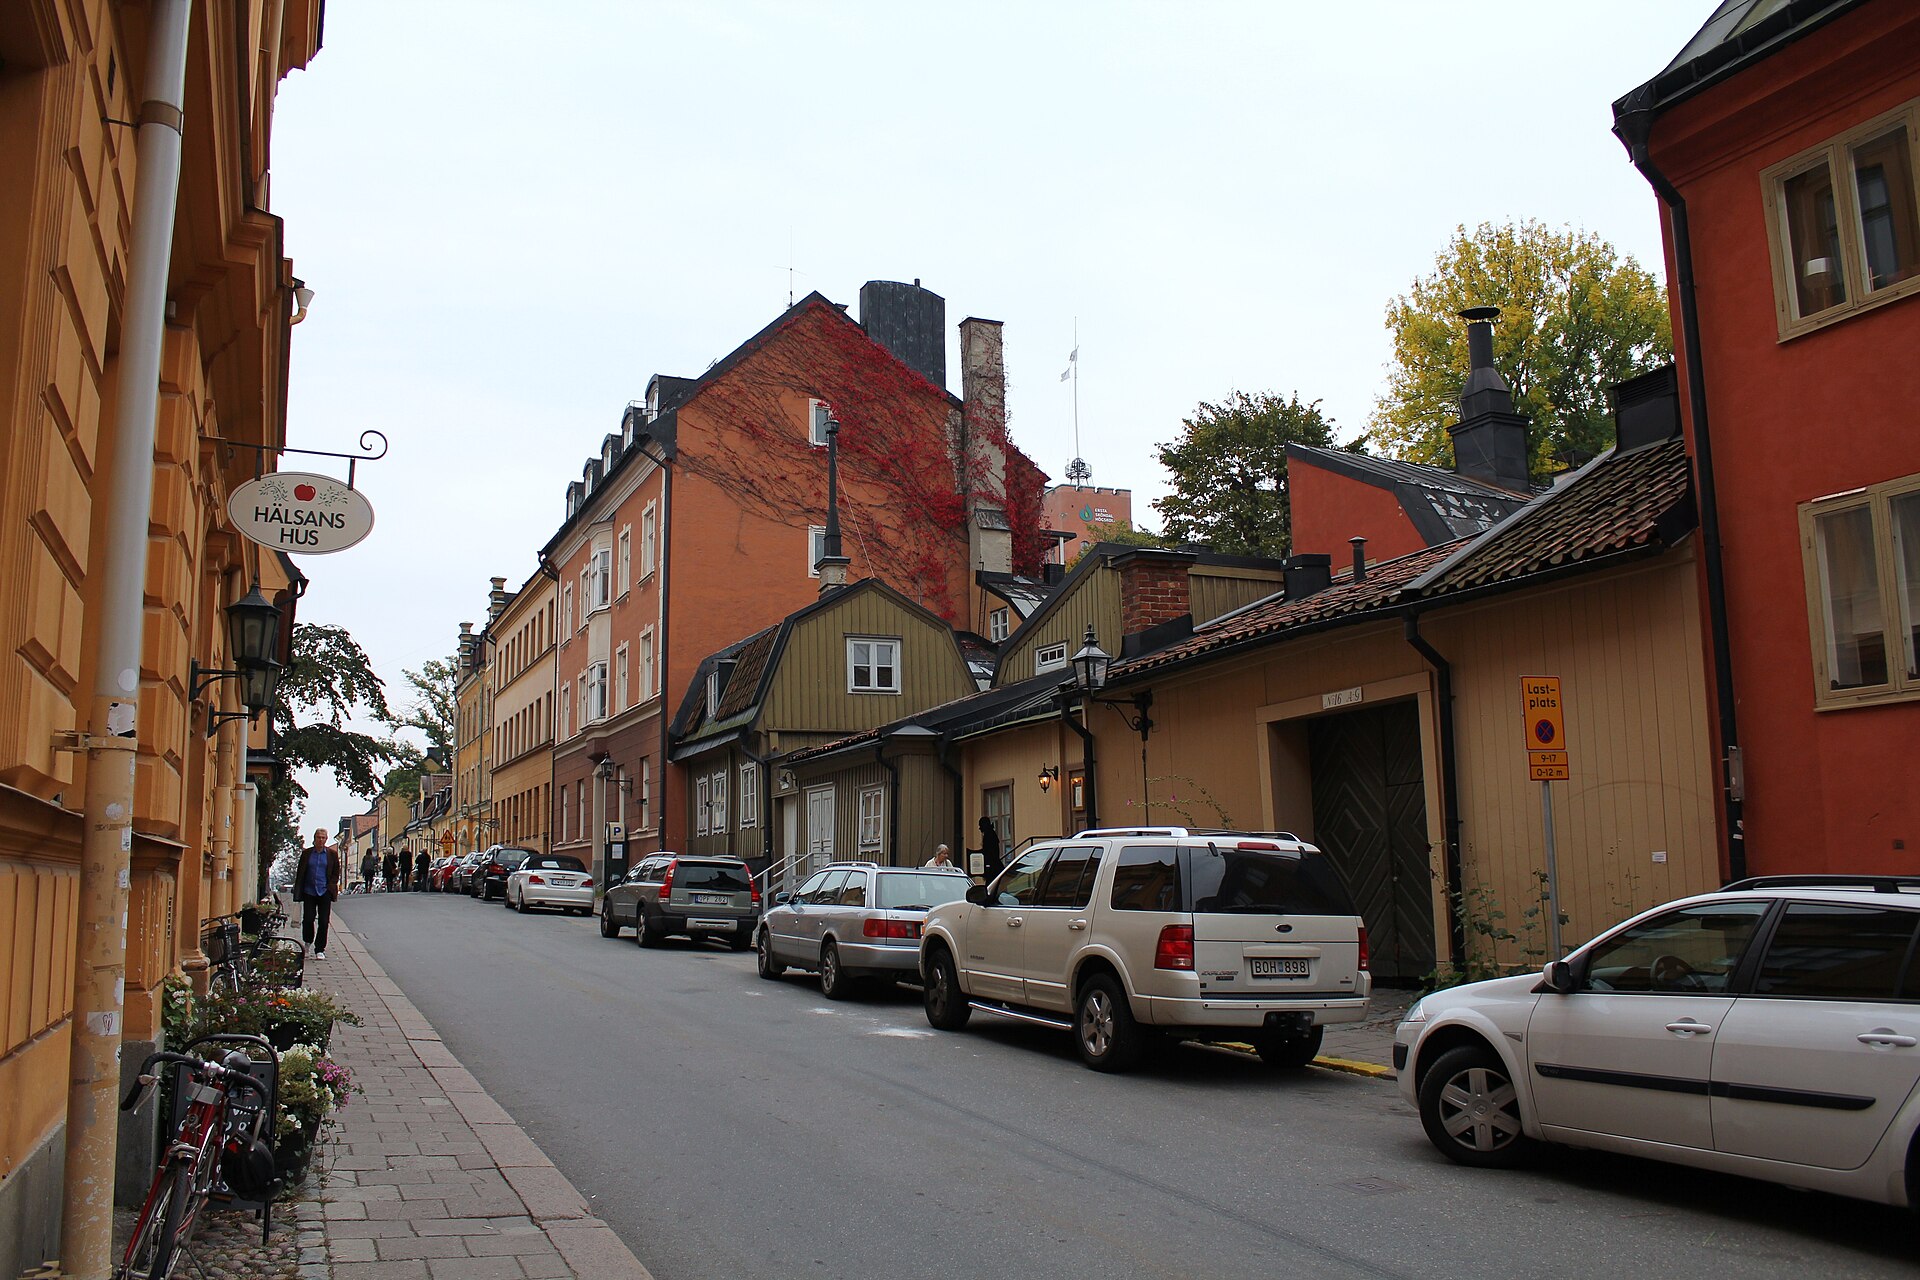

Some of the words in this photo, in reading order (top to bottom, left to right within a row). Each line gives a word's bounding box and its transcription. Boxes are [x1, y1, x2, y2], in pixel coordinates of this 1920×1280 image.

[254, 502, 346, 529] HÄLSANS
[279, 527, 319, 546] HUS
[1527, 683, 1556, 695] Last-
[1529, 697, 1557, 710] plats
[1540, 754, 1557, 763] 9-17
[1536, 768, 1554, 777] 0-12
[613, 826, 622, 836] P
[1255, 961, 1277, 973] BOH
[1284, 961, 1306, 973] 898
